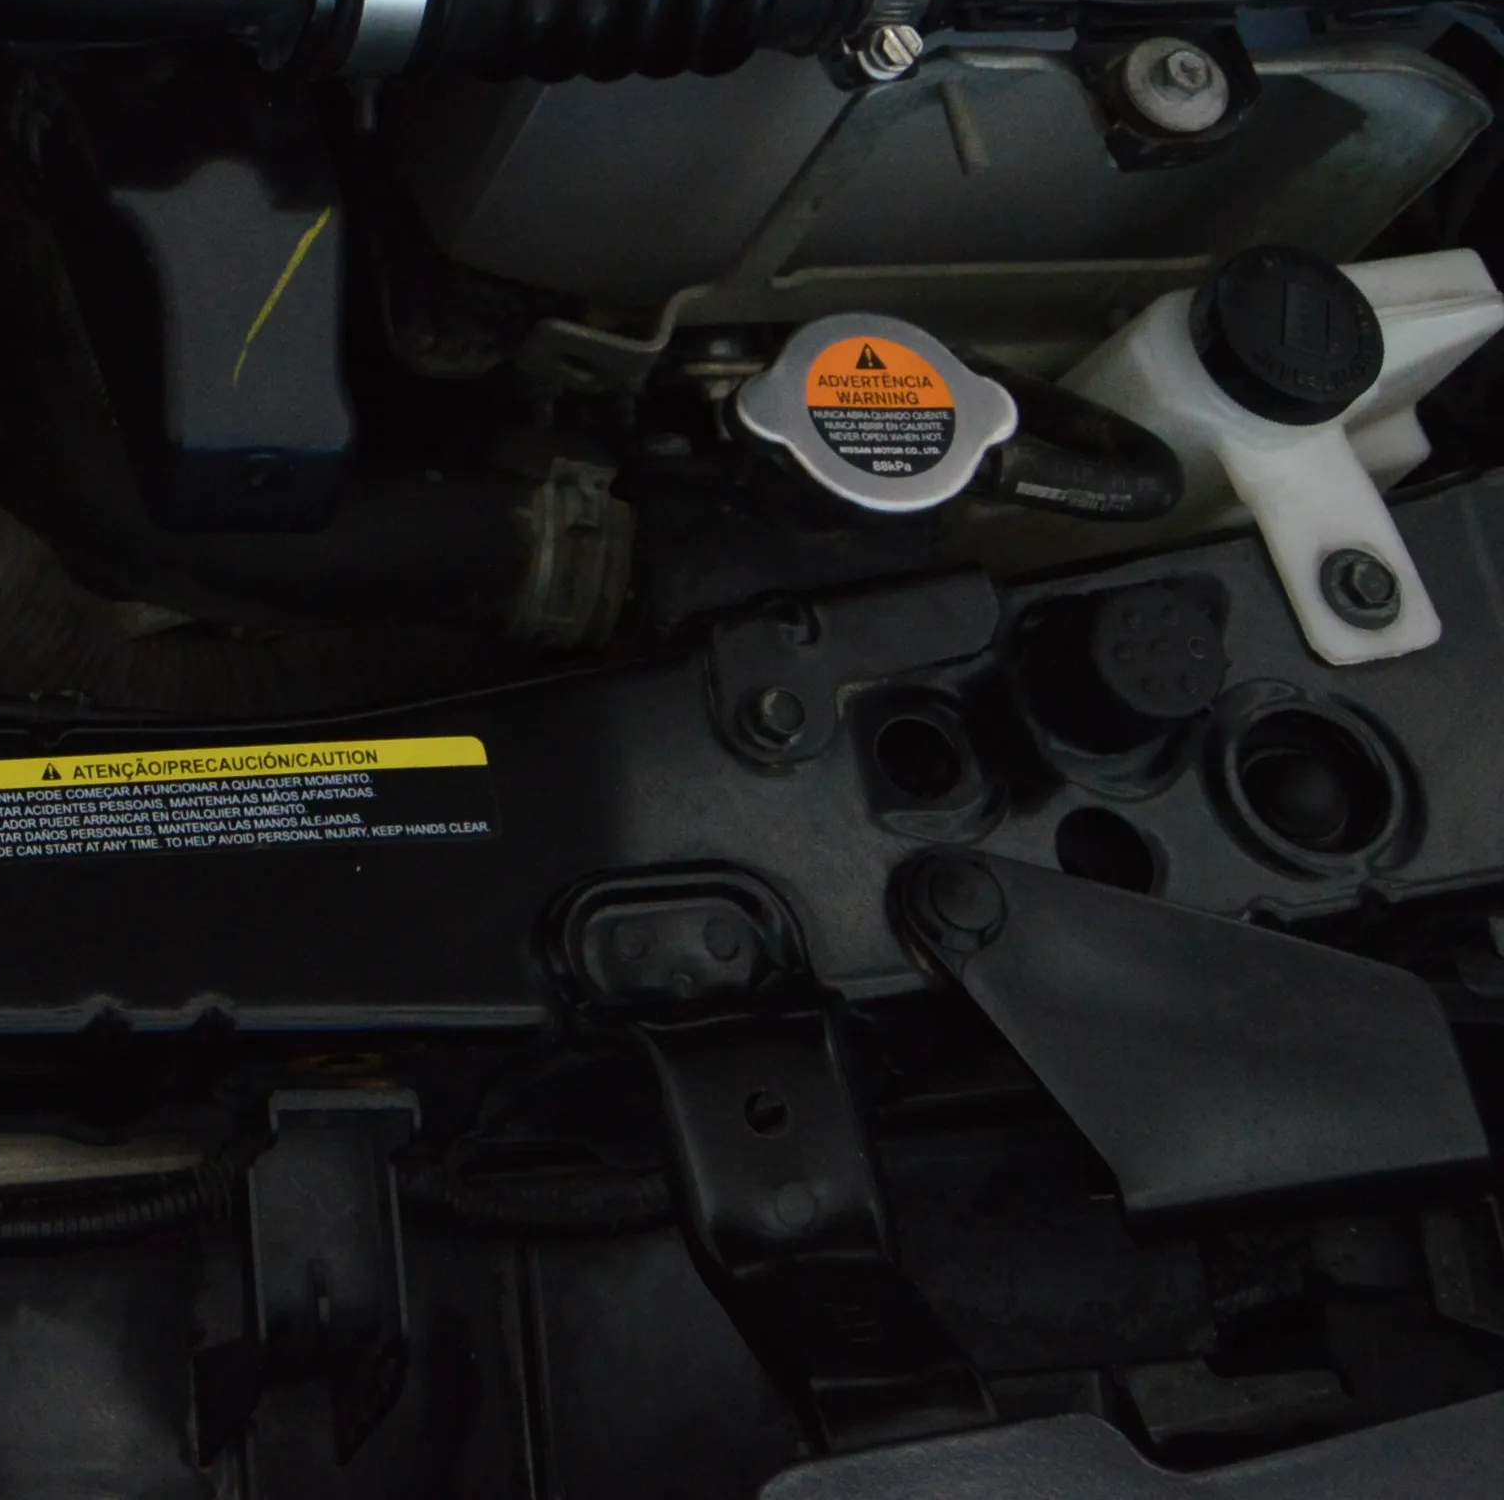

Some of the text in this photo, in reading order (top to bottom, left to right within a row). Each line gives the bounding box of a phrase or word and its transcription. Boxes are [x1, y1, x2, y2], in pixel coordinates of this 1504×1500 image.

[818, 372, 933, 388] ADVERTÊNCIA
[836, 391, 920, 405] WARNING
[813, 410, 845, 419] NUNCA
[846, 411, 871, 419] ABRA
[871, 411, 911, 420] QUANDO
[824, 421, 945, 431] NUNCA ABRIR EN CALIENTE.
[828, 432, 860, 441] NEVER
[861, 433, 889, 441] OPEN
[890, 433, 920, 441] WHEN
[839, 445, 871, 454] NISSAN
[873, 446, 903, 454] MOTOR
[73, 749, 378, 781] ATENÇÃO/PRECAUCIÓN/CAUTION
[27, 789, 62, 802] PODE
[66, 785, 129, 801] COMEÇAR
[132, 785, 142, 796] A
[144, 781, 218, 795] FUNCIONAR
[221, 780, 230, 791] A
[232, 776, 302, 792] QUALQUER
[305, 773, 372, 787] MOMENTO.
[24, 801, 96, 816] ACIDENTES
[170, 794, 240, 808] MANTENHA
[243, 793, 258, 804] AS
[262, 788, 298, 803] MÃOS
[302, 786, 377, 801] AFASTADAS.
[40, 816, 79, 828] PUEDE
[83, 812, 149, 826] ARRANCAR
[153, 811, 170, 822] EN
[173, 807, 240, 822] CUALQUIER
[244, 804, 308, 817] MOMENTO.
[26, 827, 68, 842] DAÑOS
[159, 821, 226, 834] MANTENGA
[229, 819, 250, 831] LAS
[254, 817, 298, 829] MANOS
[301, 813, 364, 827] ALEJADAS.
[17, 845, 42, 857] CAN
[46, 843, 82, 855] START
[86, 842, 100, 853] AT
[103, 841, 126, 852] ANY
[131, 839, 162, 850] TIME.
[167, 838, 181, 849] TO
[185, 836, 215, 848] HELP
[219, 834, 254, 846] AVOID
[258, 830, 322, 844] PERSONAL
[325, 827, 369, 841] INJURY,
[372, 826, 403, 838] KEEP
[406, 823, 445, 836] HANDS
[450, 821, 491, 834] CLEAR.
